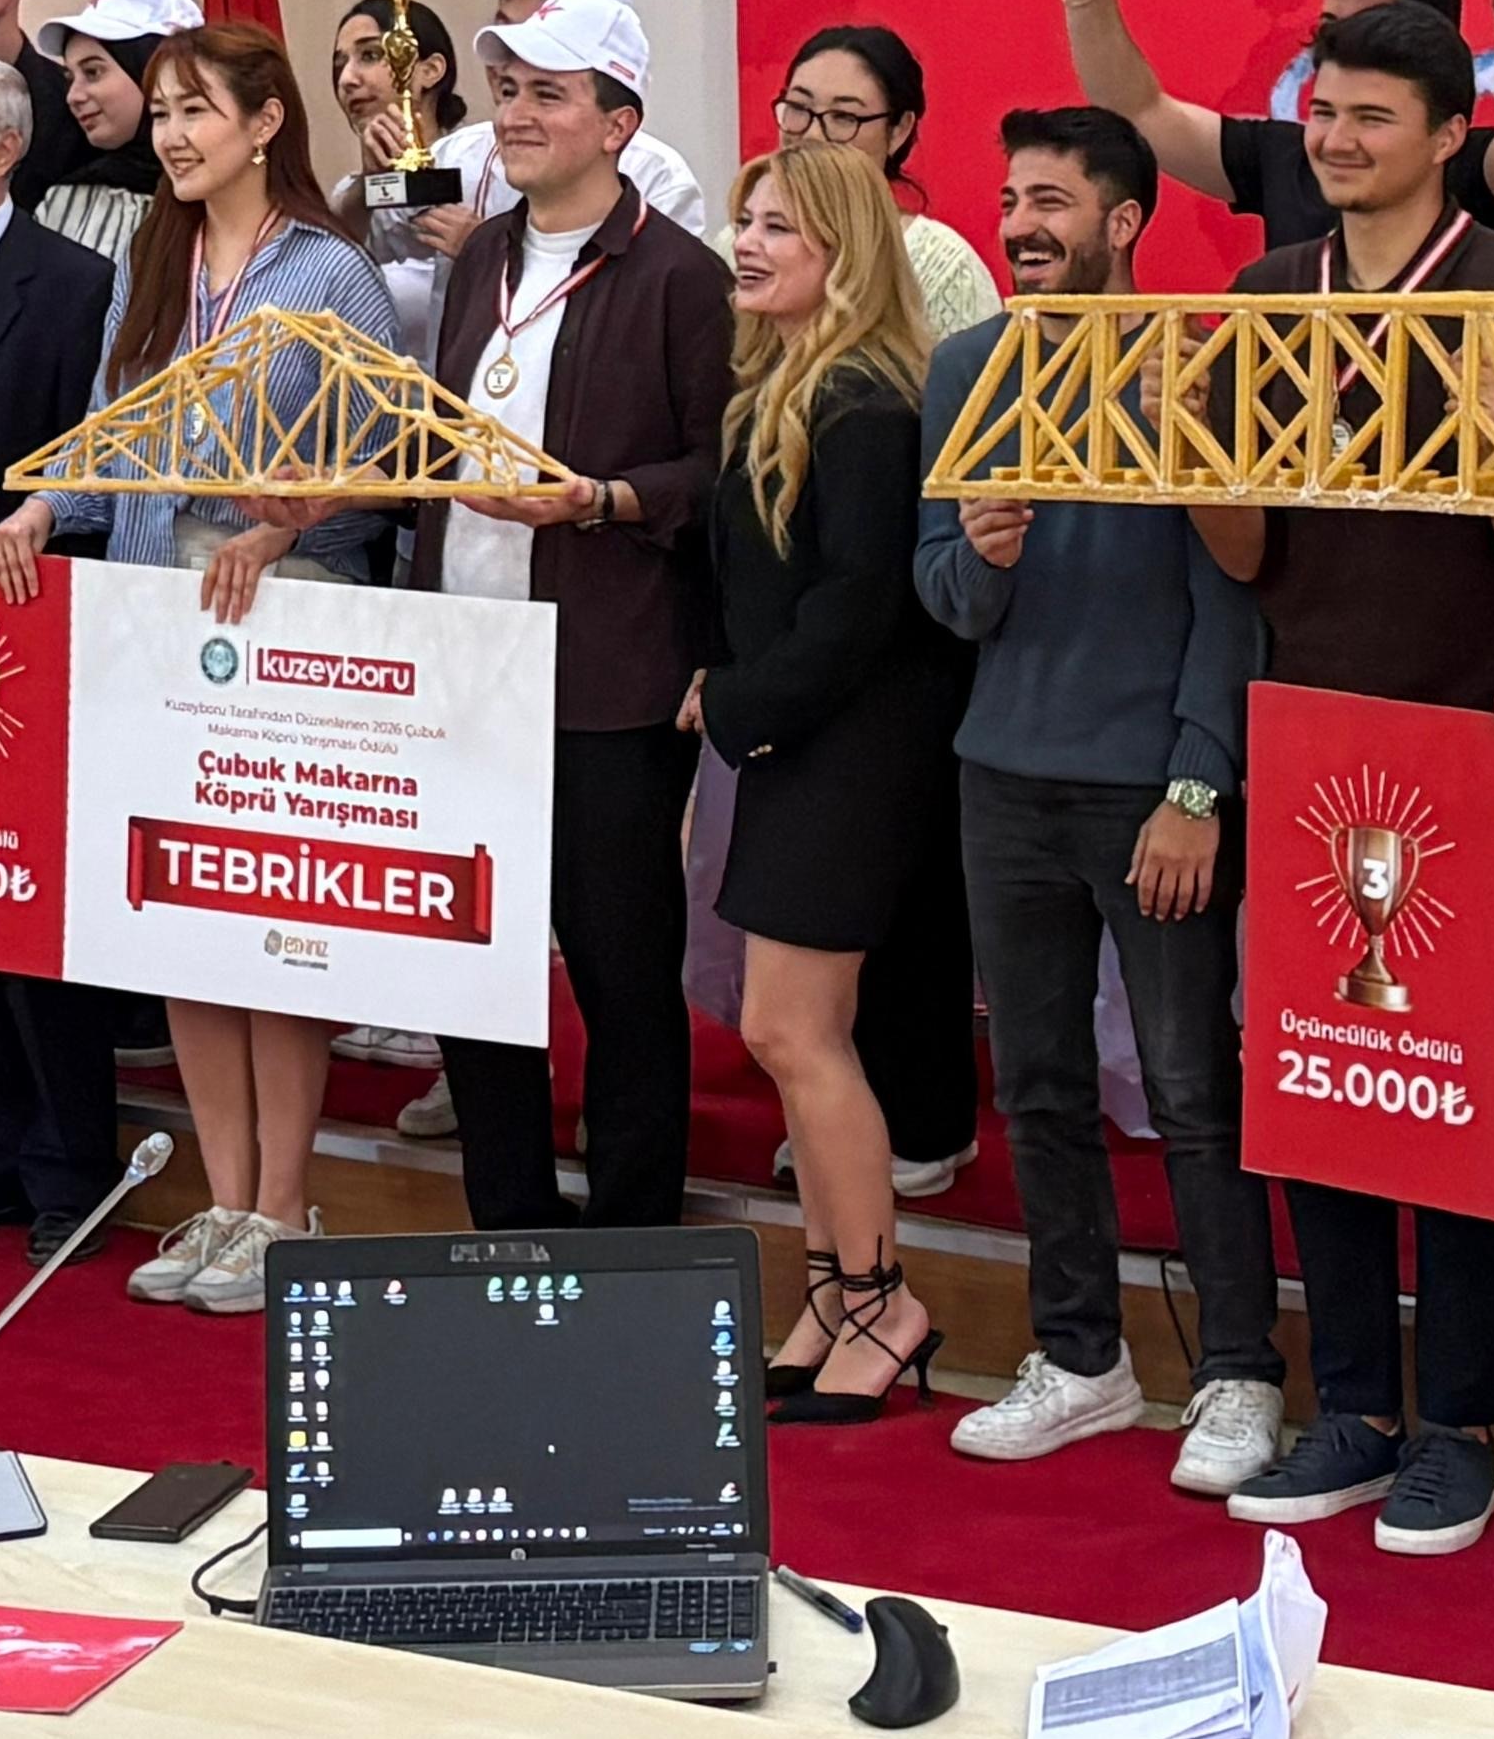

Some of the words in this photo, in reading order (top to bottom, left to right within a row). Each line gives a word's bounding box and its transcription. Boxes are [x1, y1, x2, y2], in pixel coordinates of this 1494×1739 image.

[262, 648, 410, 691] kuzeyboru
[372, 721, 403, 736] 2026
[198, 749, 286, 782] Çubuk
[295, 761, 418, 797] Makarna
[195, 780, 276, 814] Köprü
[284, 791, 418, 829] Yarışması
[158, 838, 455, 921] TEBRİKLER
[1361, 858, 1390, 900] 3
[1280, 1008, 1393, 1053] Üçüncülük
[1398, 1030, 1464, 1065] Ödülü
[1277, 1049, 1475, 1126] 25.000₺
